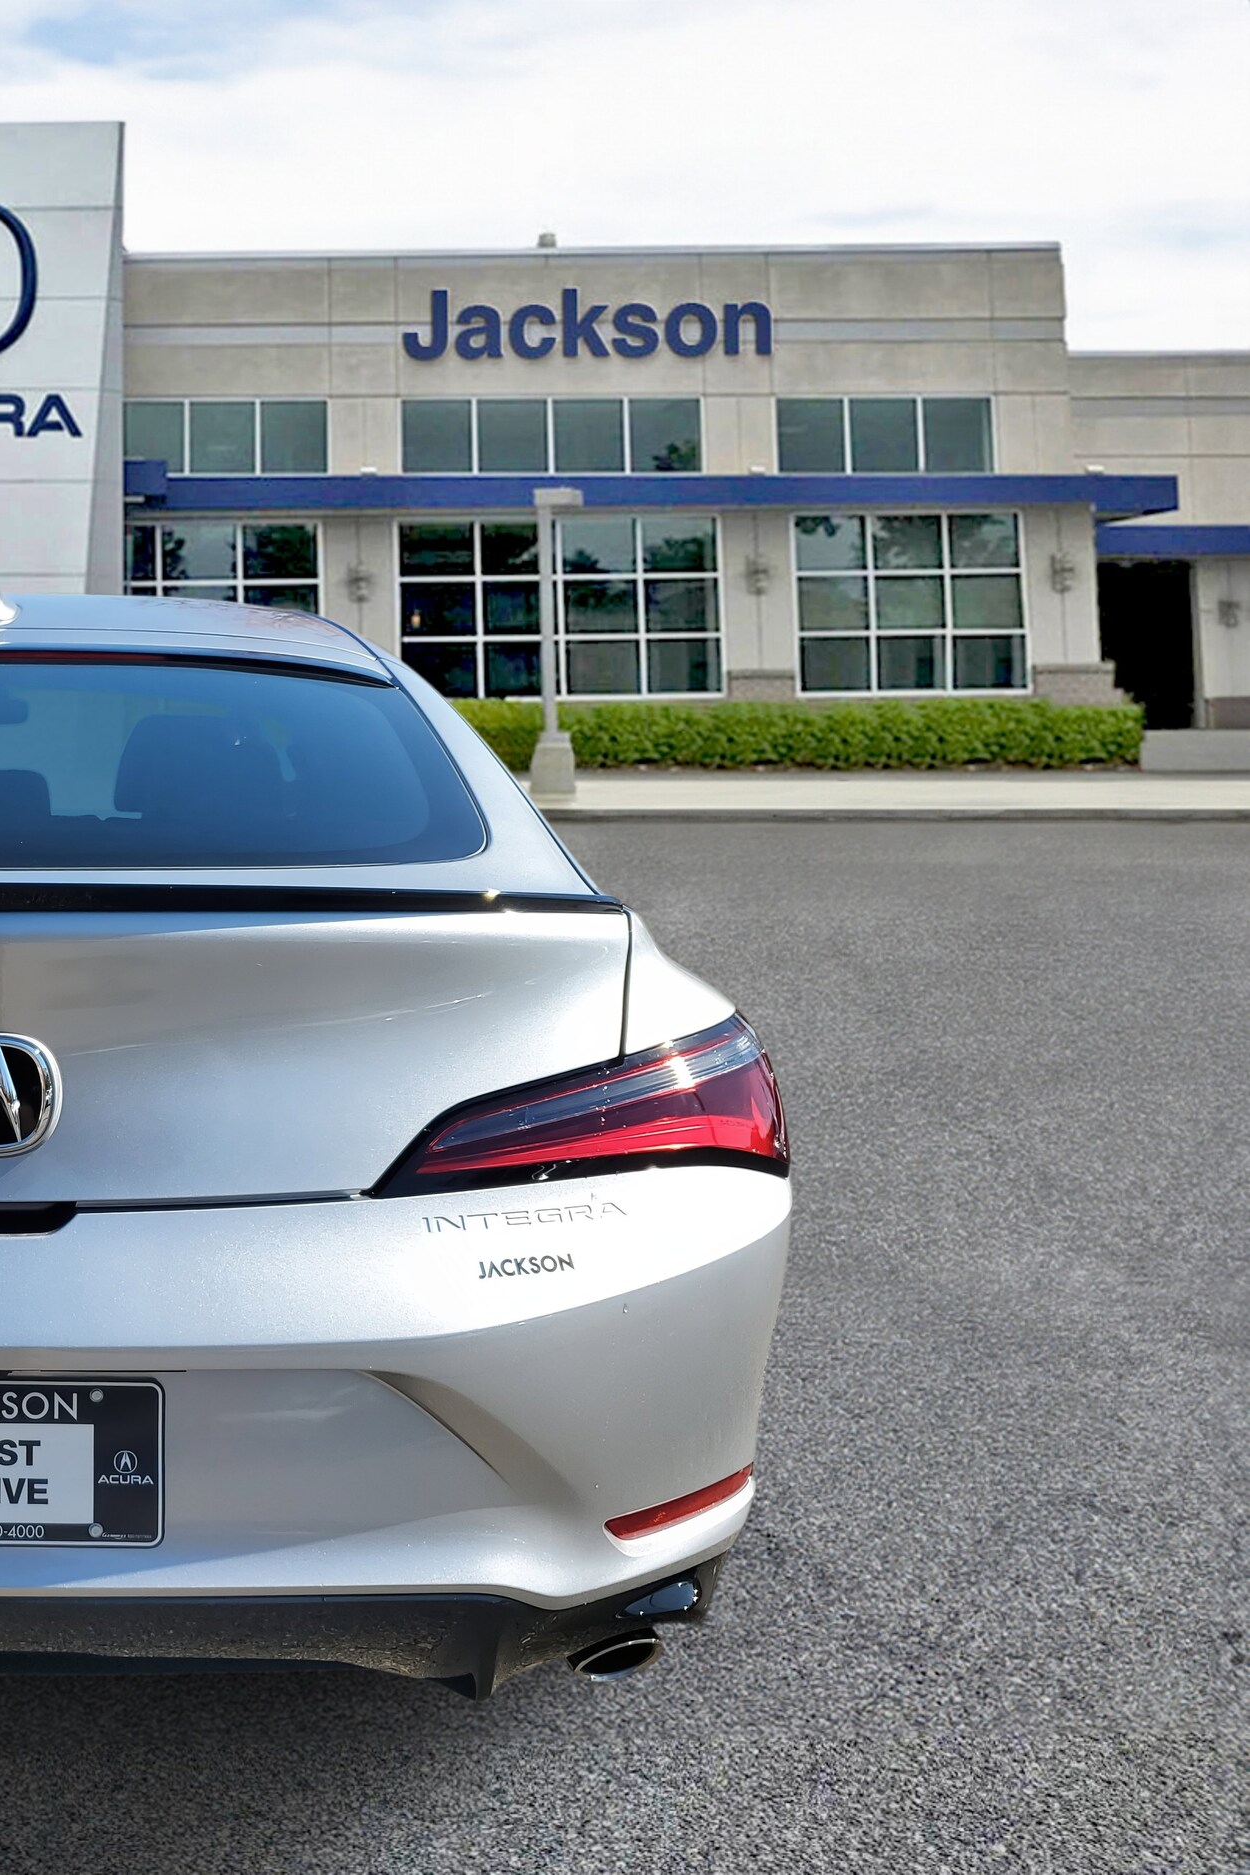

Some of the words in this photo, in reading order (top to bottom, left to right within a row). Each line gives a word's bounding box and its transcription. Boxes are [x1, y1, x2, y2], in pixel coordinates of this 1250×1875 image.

[403, 289, 772, 361] Jackson
[422, 1202, 626, 1232] INTEGRA
[478, 1254, 575, 1279] JACKSON
[97, 1474, 154, 1485] ACURA
